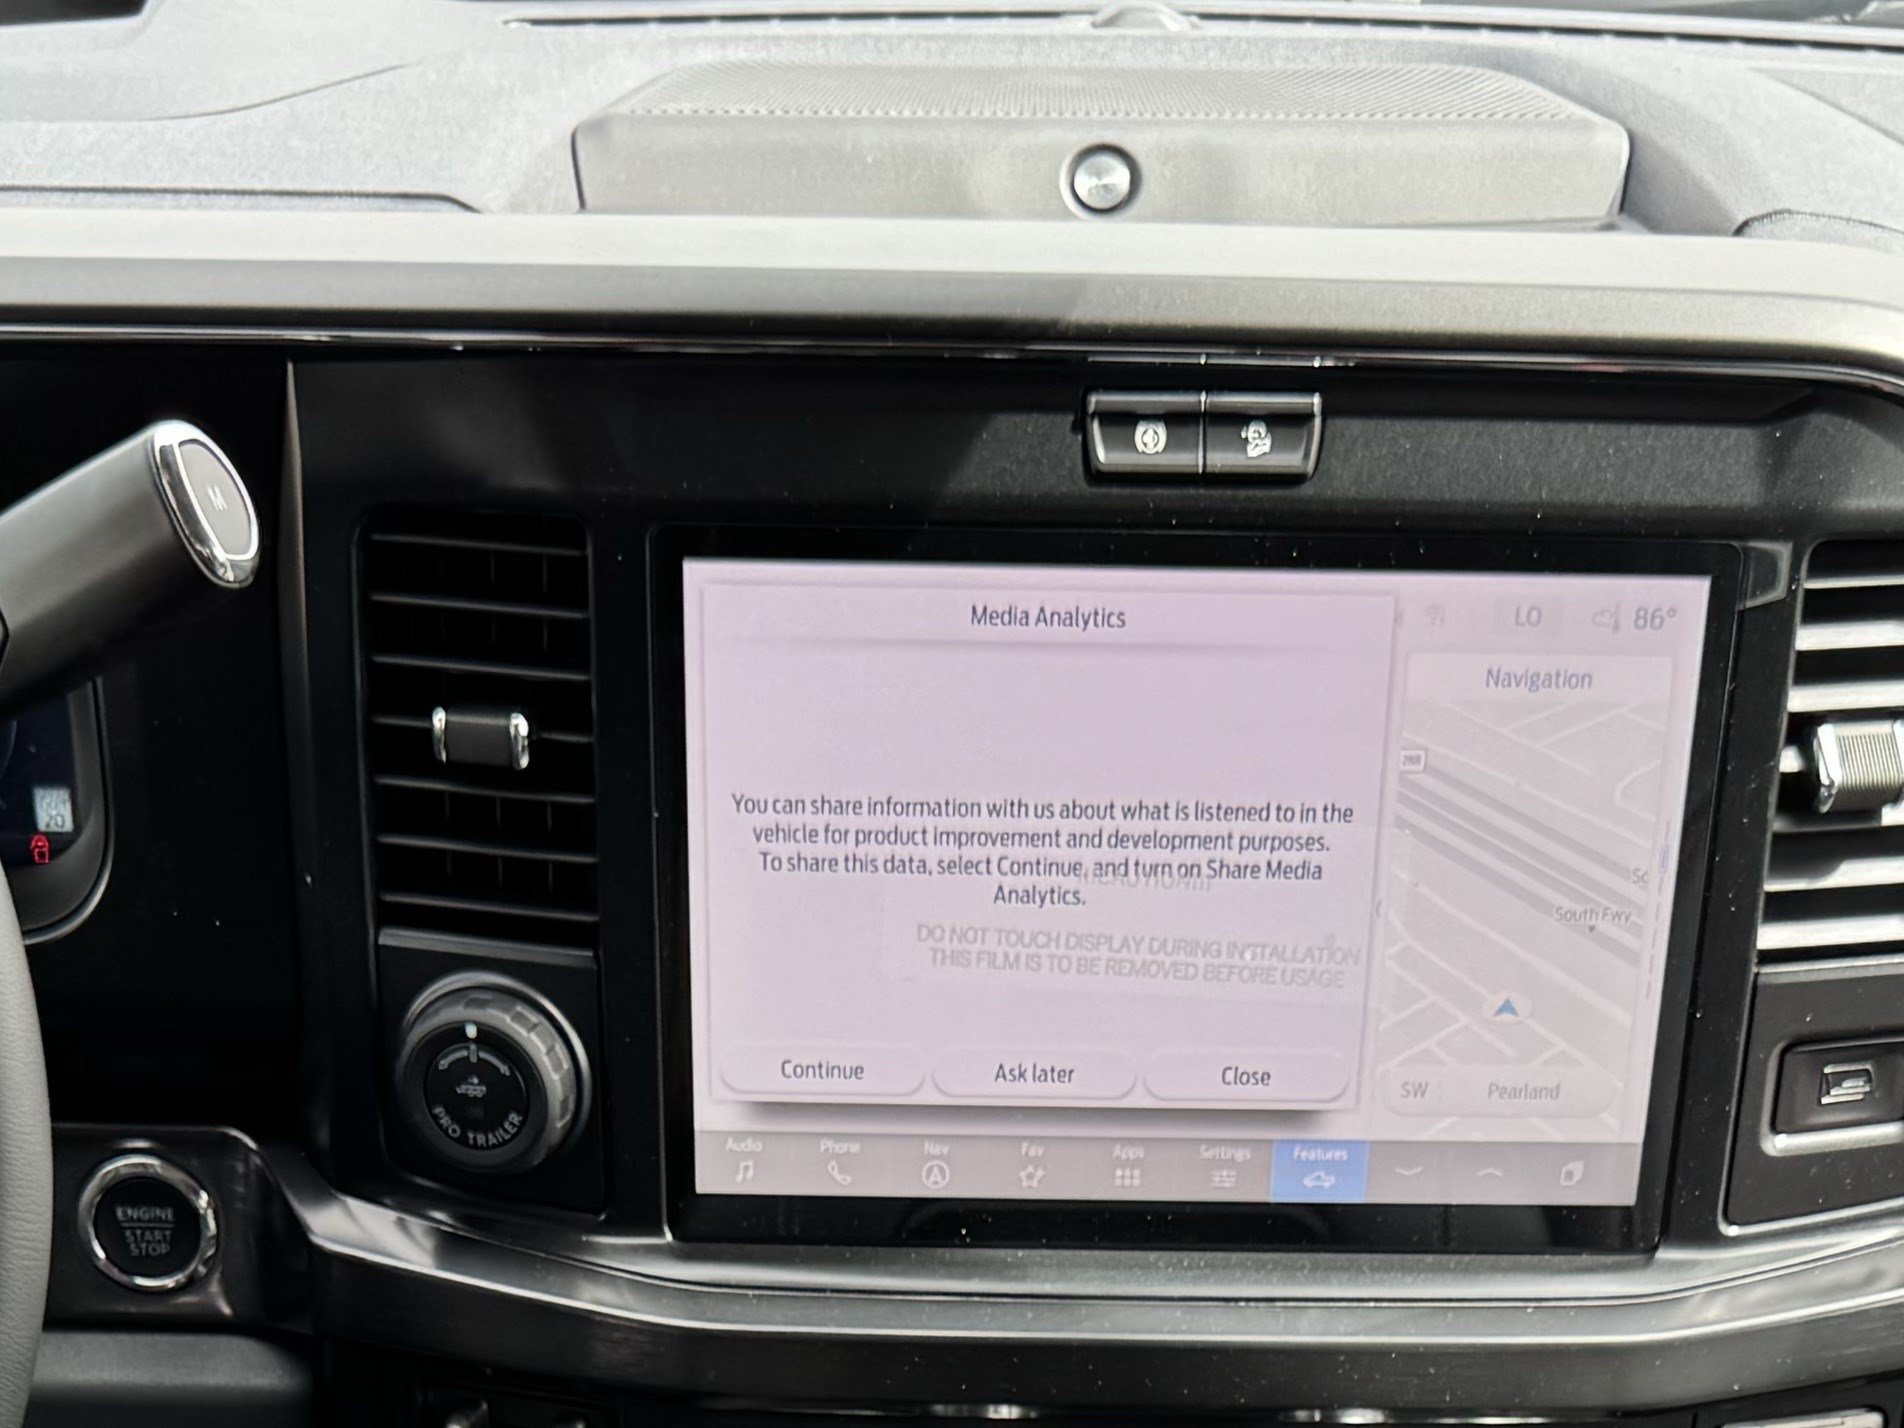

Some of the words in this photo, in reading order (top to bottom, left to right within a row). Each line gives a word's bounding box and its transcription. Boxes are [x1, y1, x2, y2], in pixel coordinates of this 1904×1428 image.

[971, 604, 1029, 627] Media
[1035, 604, 1127, 632] Analytics
[1514, 606, 1542, 628] LO
[1485, 667, 1593, 692] Navigation
[732, 793, 768, 815] You
[772, 799, 806, 816] can
[811, 795, 863, 816] share
[867, 796, 982, 818] information
[986, 798, 1029, 819] with
[1034, 804, 1055, 819] us
[1059, 799, 1116, 822] about
[1121, 800, 1170, 822] what
[1175, 801, 1190, 822] is
[1194, 801, 1270, 823] listened
[1275, 803, 1295, 824] to
[1299, 802, 1317, 824] in
[1322, 802, 1354, 824] the
[752, 823, 820, 845] vehicle
[823, 823, 849, 845] for
[855, 825, 928, 849] product
[933, 826, 1062, 852] improvement
[1066, 829, 1103, 850] and
[1106, 829, 1234, 854] development
[1238, 832, 1331, 855] purposes.
[759, 851, 782, 873] To
[787, 852, 839, 874] share
[844, 852, 879, 874] this
[882, 853, 934, 877] data,
[937, 855, 992, 877] select
[997, 855, 1087, 879] Continue,
[1093, 857, 1129, 878] and
[1134, 859, 1173, 879] turn
[1177, 862, 1202, 879] on
[1206, 859, 1261, 880] Share
[1265, 860, 1323, 881] Media
[993, 884, 1086, 908] Analytics.
[1555, 906, 1596, 924] South
[1601, 907, 1632, 925] Fwy
[916, 923, 945, 943] DO
[949, 924, 990, 945] NOT
[994, 927, 1061, 950] TOUCH
[1065, 931, 1145, 954] DISPLAY
[1149, 936, 1221, 959] DURING
[930, 948, 972, 968] THIS
[976, 951, 1021, 971] FILM
[1025, 953, 1042, 972] IS
[1047, 955, 1072, 974] TO
[1077, 956, 1101, 976] BE
[1105, 958, 1197, 981] REMOVED
[1203, 963, 1278, 985] BEFORE
[1281, 967, 1345, 989] USAGE
[781, 1059, 864, 1080] Continue
[995, 1063, 1027, 1084] Ask
[1032, 1063, 1074, 1085] later
[1221, 1066, 1271, 1087] Close
[1401, 1082, 1429, 1099] SW
[1487, 1081, 1561, 1100] Pearland
[432, 1105, 461, 1138] PRO
[467, 1112, 523, 1147] TRAILER
[820, 1139, 860, 1154] Phone
[925, 1141, 949, 1155] Nav
[1021, 1142, 1044, 1157] Fav
[1293, 1146, 1348, 1162] Features
[116, 1206, 174, 1221] ENGINE
[125, 1229, 171, 1243] START
[130, 1243, 170, 1257] STOP
